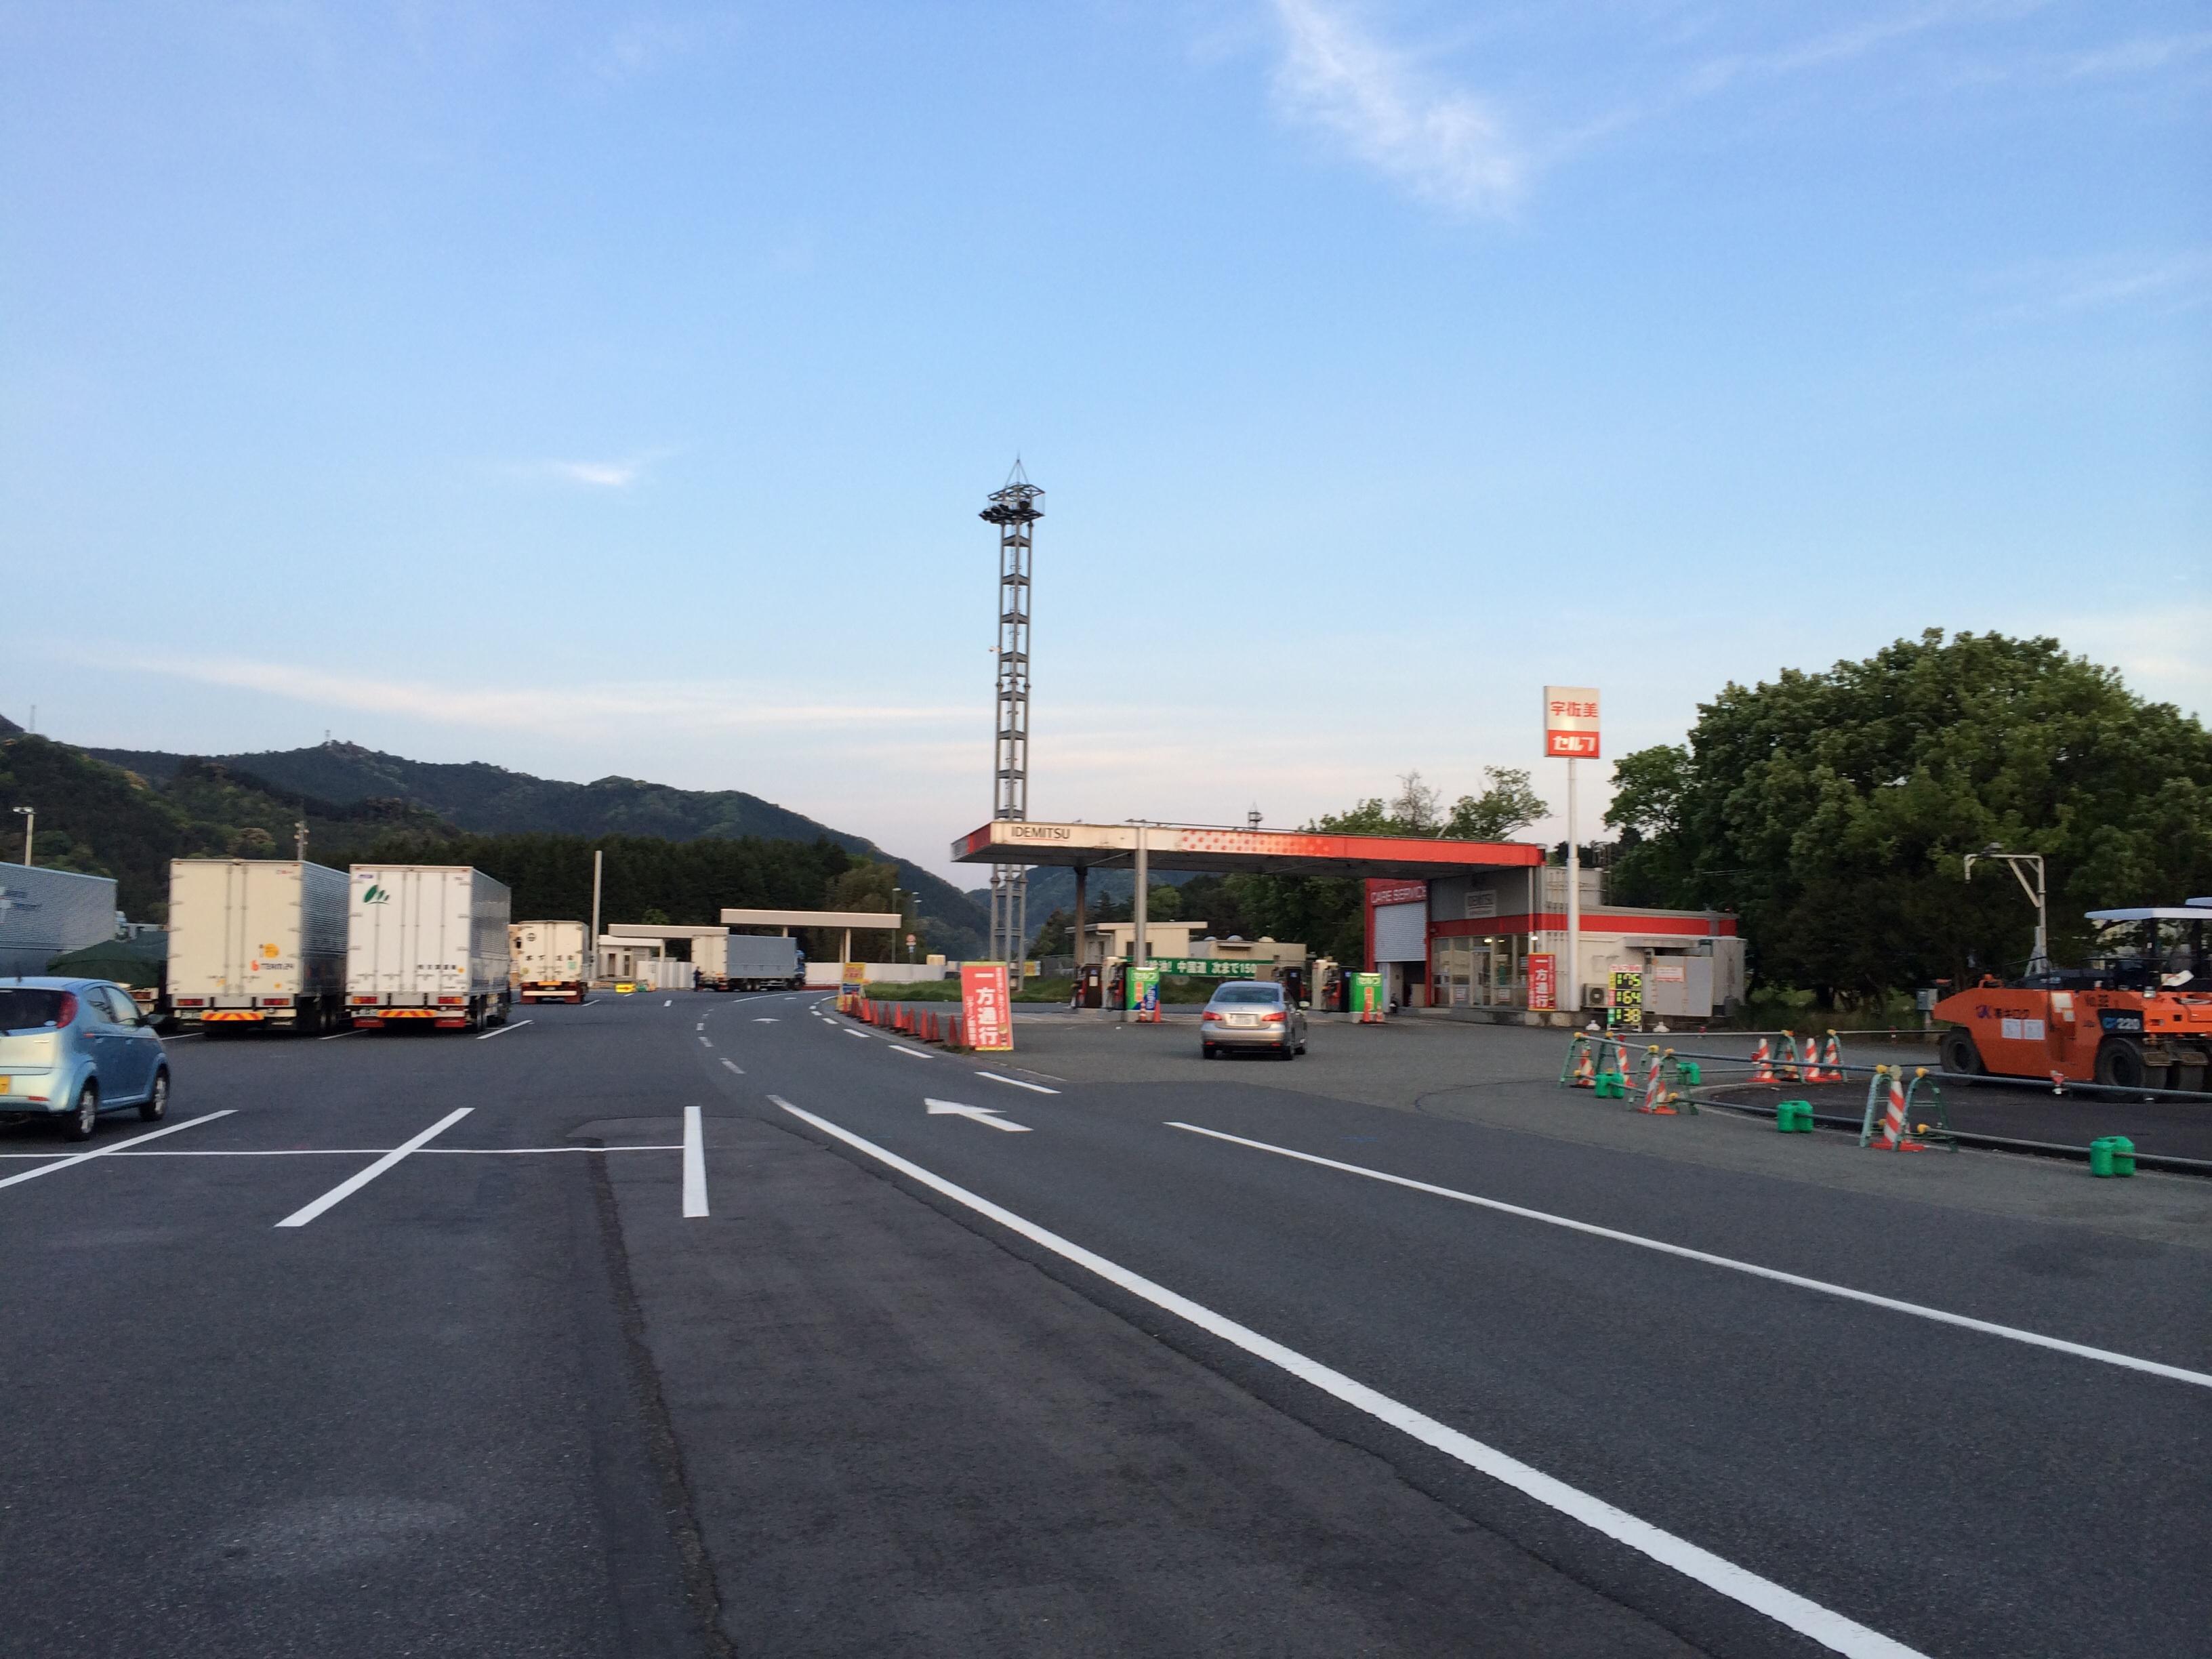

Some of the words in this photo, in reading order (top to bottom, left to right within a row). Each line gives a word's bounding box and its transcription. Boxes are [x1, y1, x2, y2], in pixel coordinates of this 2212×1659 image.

[1550, 701, 1598, 717] 宇佐美
[1553, 735, 1597, 752] セルフ
[1012, 826, 1071, 839] IDEMITSU
[1535, 959, 1549, 1008] 一方通行
[1617, 973, 1641, 987] 175
[1616, 990, 1641, 1004] 164
[975, 972, 999, 1045] 一方通行
[1616, 1008, 1641, 1022] 138
